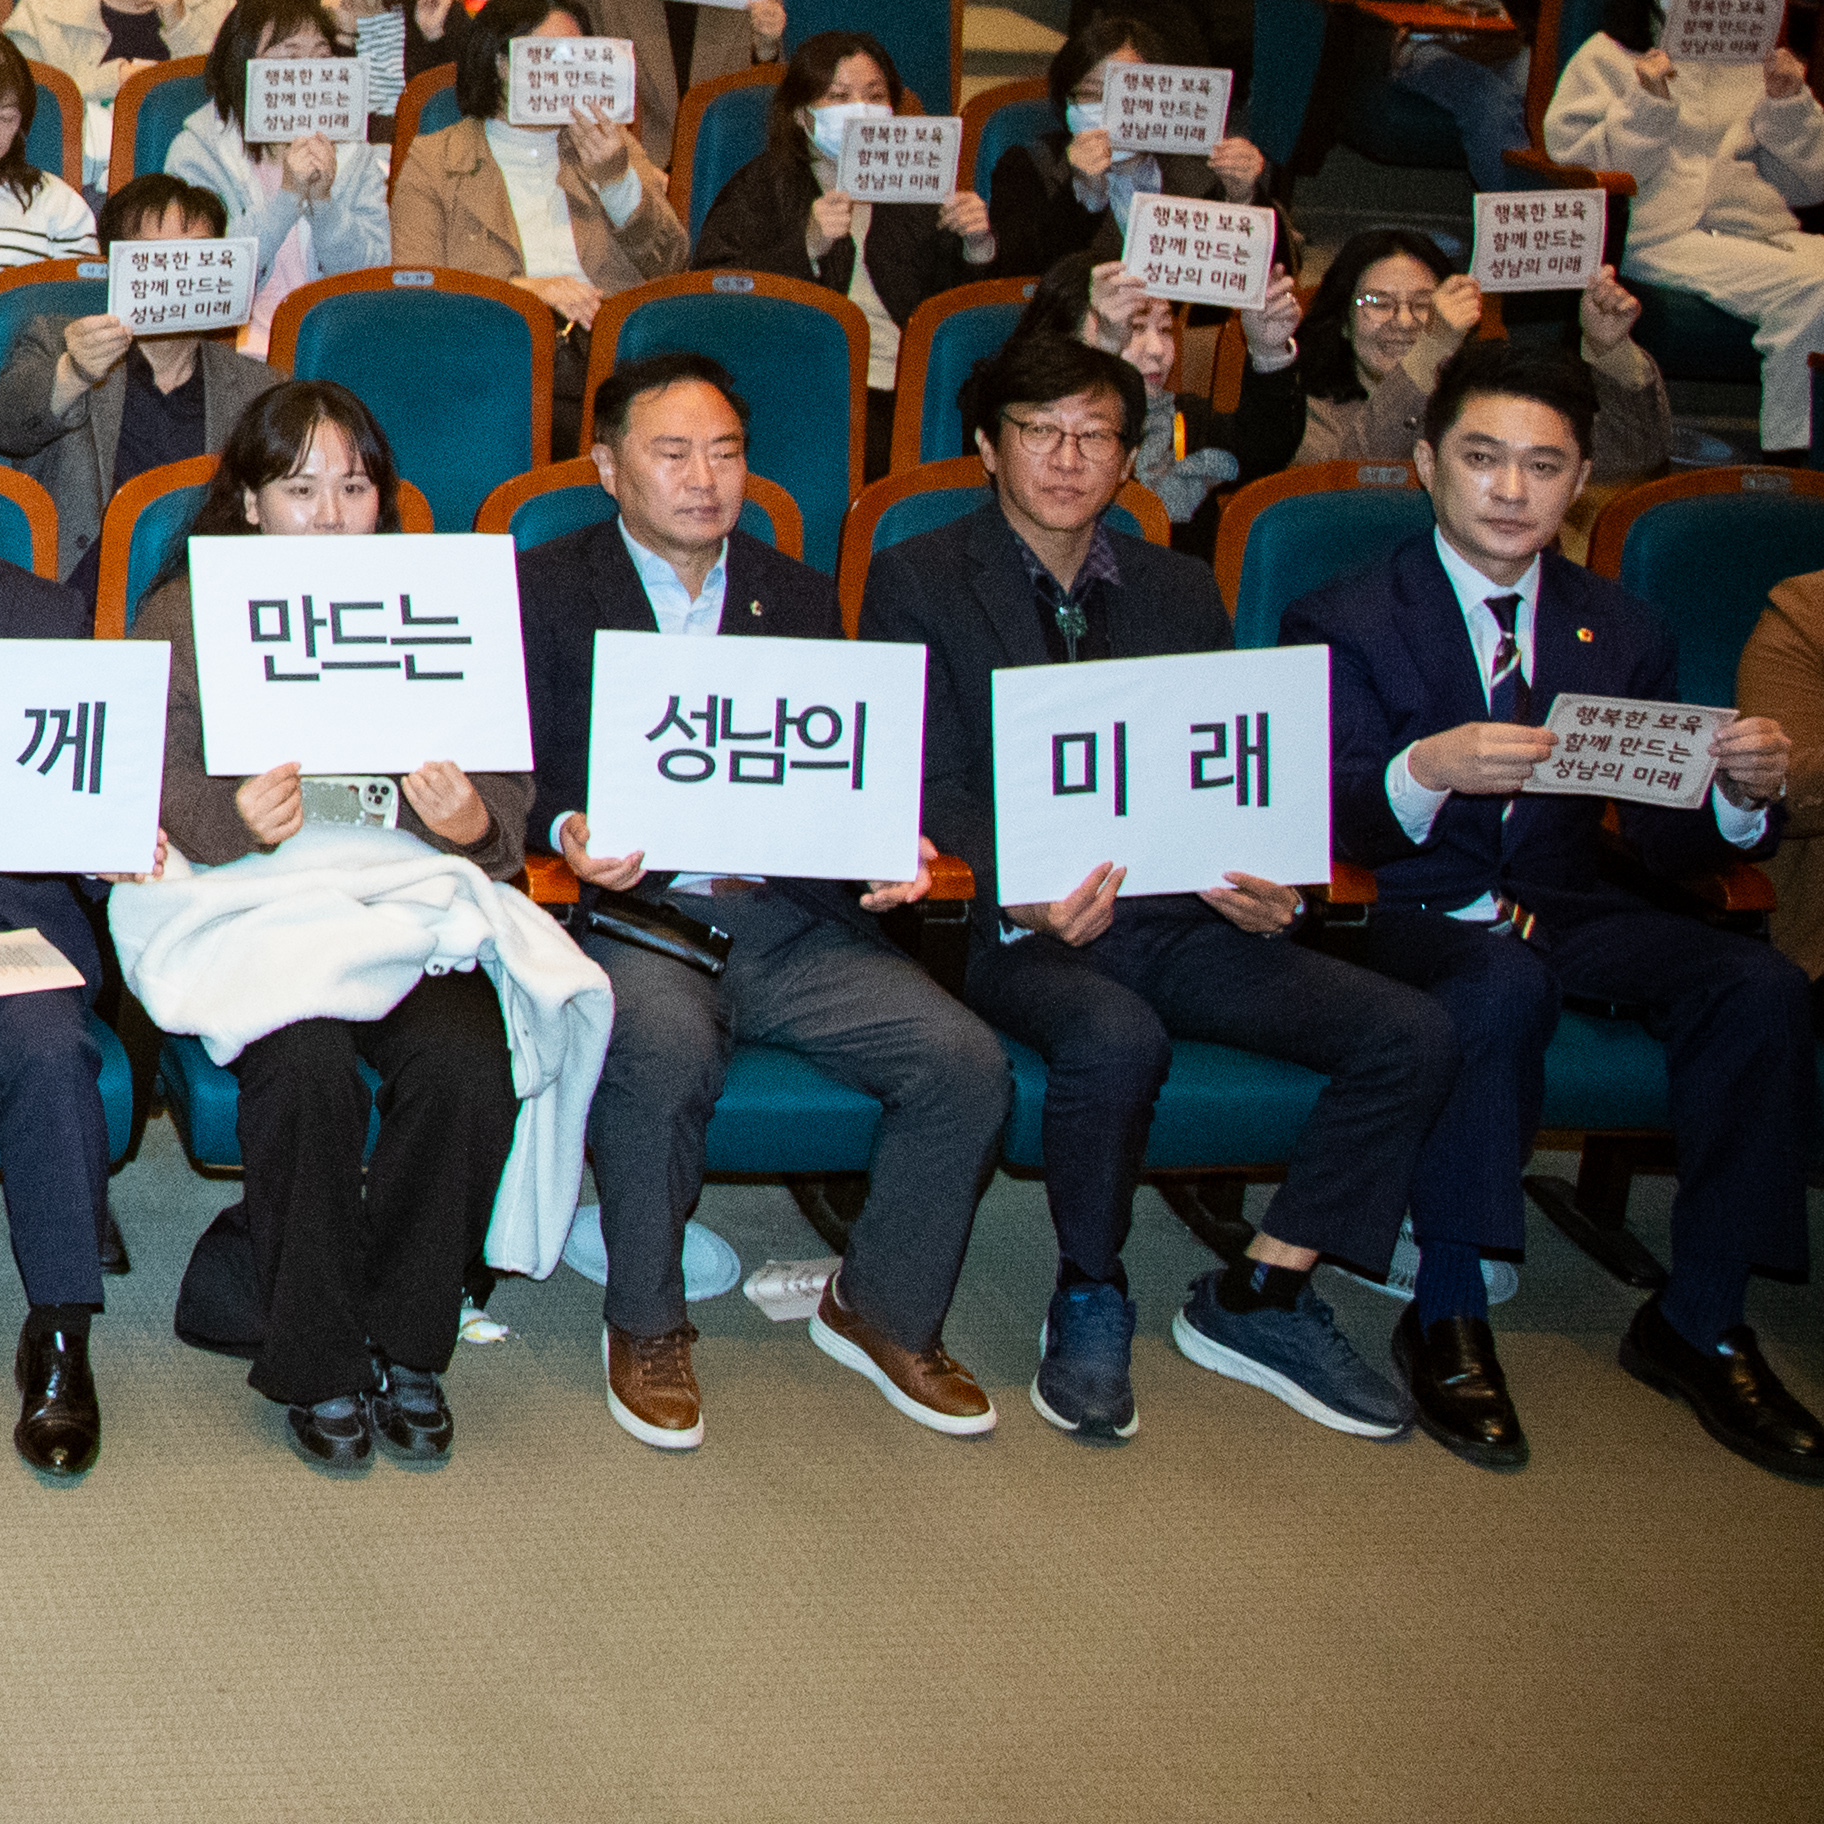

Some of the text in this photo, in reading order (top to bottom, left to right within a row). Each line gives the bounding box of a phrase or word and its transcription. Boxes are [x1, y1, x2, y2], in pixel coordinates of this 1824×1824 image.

[265, 68, 350, 85] 행복한 보육
[1123, 72, 1211, 96] 행복한 보육
[264, 91, 349, 109] 함께 만드는
[1121, 96, 1208, 120] 함께 만드는
[264, 113, 349, 131] 성남의 미래
[1118, 121, 1206, 141] 성남의 미래
[860, 125, 943, 144] 행복한 보육
[858, 148, 941, 168] 함께 만드는
[855, 173, 940, 191] 성남의 미래
[1153, 205, 1253, 237] 행복한 보육
[1494, 201, 1586, 223] 행복한 보육
[1149, 233, 1250, 265] 함께 만드는
[1493, 230, 1584, 252] 함께 만드는
[131, 249, 234, 272] 행복한 보육
[1490, 256, 1582, 279] 성남의 미래
[130, 277, 232, 299] 함께 만드는
[1145, 262, 1248, 291] 성남의 미래
[130, 300, 231, 324] 성남의 미래
[249, 595, 471, 680] 만드는
[1578, 706, 1701, 735] 행복한 보육
[646, 695, 866, 789] 성남의
[1565, 731, 1691, 762] 함께 만드는
[1554, 759, 1683, 789] 성남의 미래
